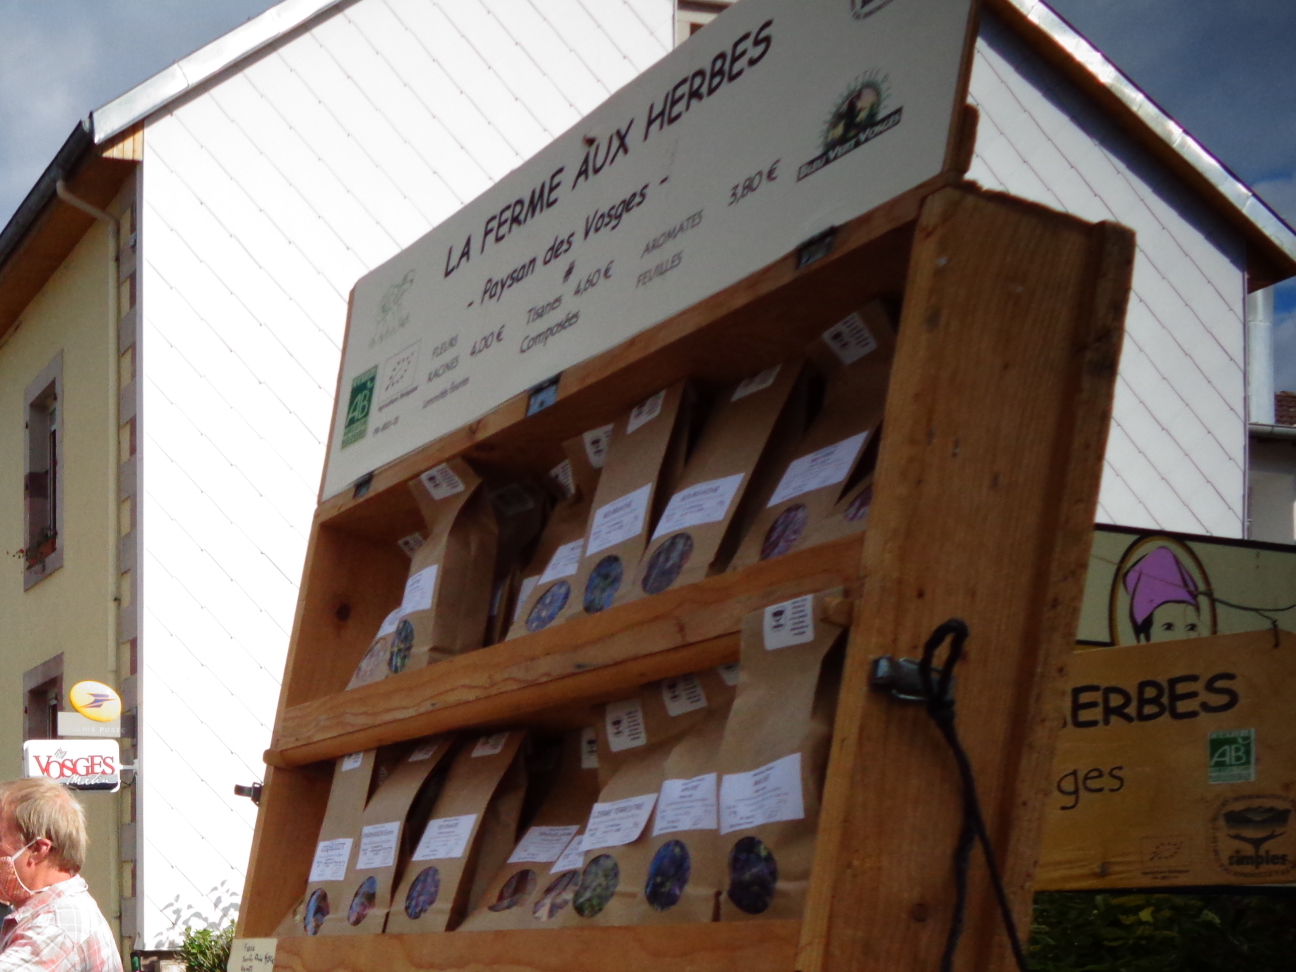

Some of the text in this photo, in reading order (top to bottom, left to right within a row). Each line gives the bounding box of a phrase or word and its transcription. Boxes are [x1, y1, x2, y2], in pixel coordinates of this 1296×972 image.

[444, 19, 774, 279] LA FERME AUX HERBES
[728, 159, 781, 207] 3,80 €
[481, 256, 537, 305] Paysan
[543, 231, 575, 266] des
[584, 183, 649, 241] Vosges
[641, 209, 704, 260] AROMATES
[573, 260, 615, 297] 4,60 €
[635, 251, 684, 289] FEUILLES
[526, 295, 562, 325] Tisanes
[431, 334, 460, 360] FLEURS
[470, 324, 506, 358] 4,00 €
[519, 309, 580, 354] Composées
[427, 355, 460, 384] RACINES
[1061, 672, 1240, 728] ERBES
[33, 755, 115, 779] VOSGES
[1210, 744, 1247, 766] AB
[1056, 765, 1125, 811] ges
[1228, 850, 1288, 869] simples
